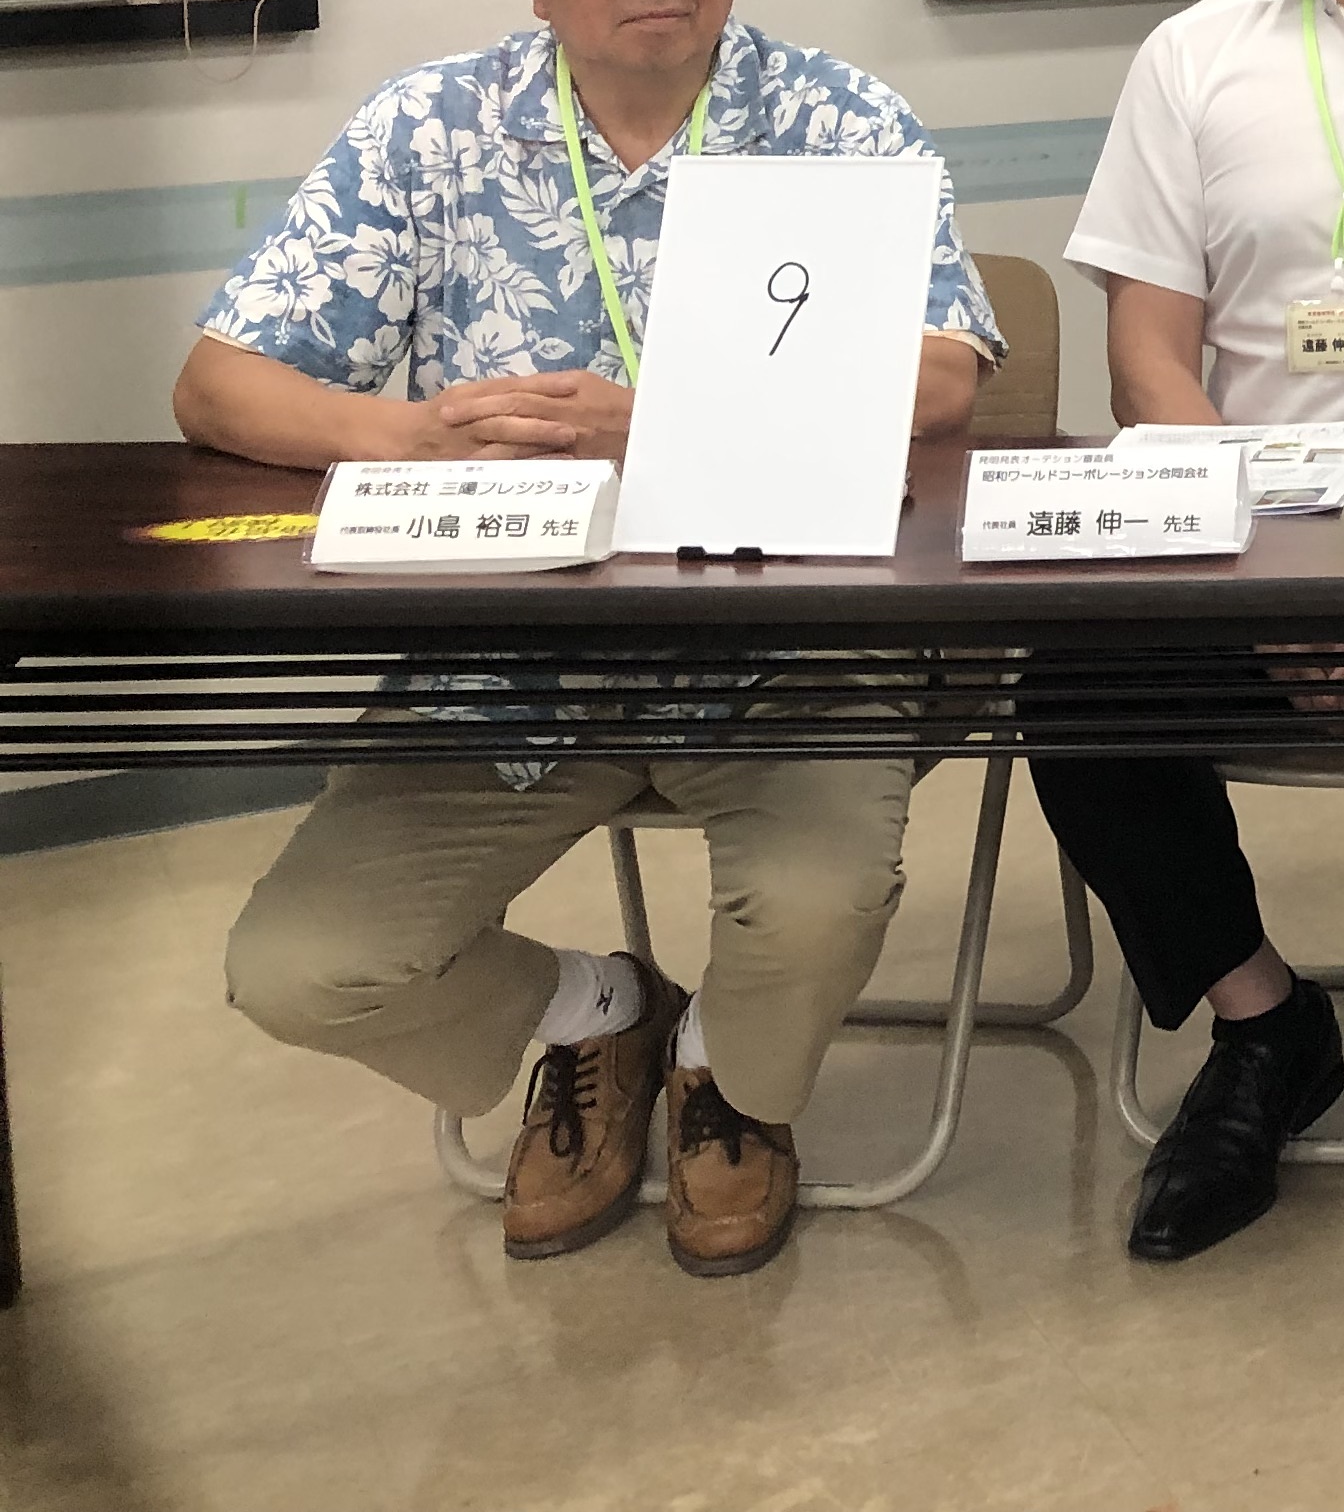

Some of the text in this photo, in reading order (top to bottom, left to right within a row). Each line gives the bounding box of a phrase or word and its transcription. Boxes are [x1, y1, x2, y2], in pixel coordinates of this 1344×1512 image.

[767, 262, 809, 356] 9
[354, 481, 430, 497] 株式会社
[407, 515, 460, 539] 小島
[476, 514, 530, 538] 裕司
[540, 519, 579, 537] 先生
[1027, 511, 1082, 537] 遠藤
[1096, 509, 1149, 535] 伸一
[1163, 515, 1201, 533] 先生
